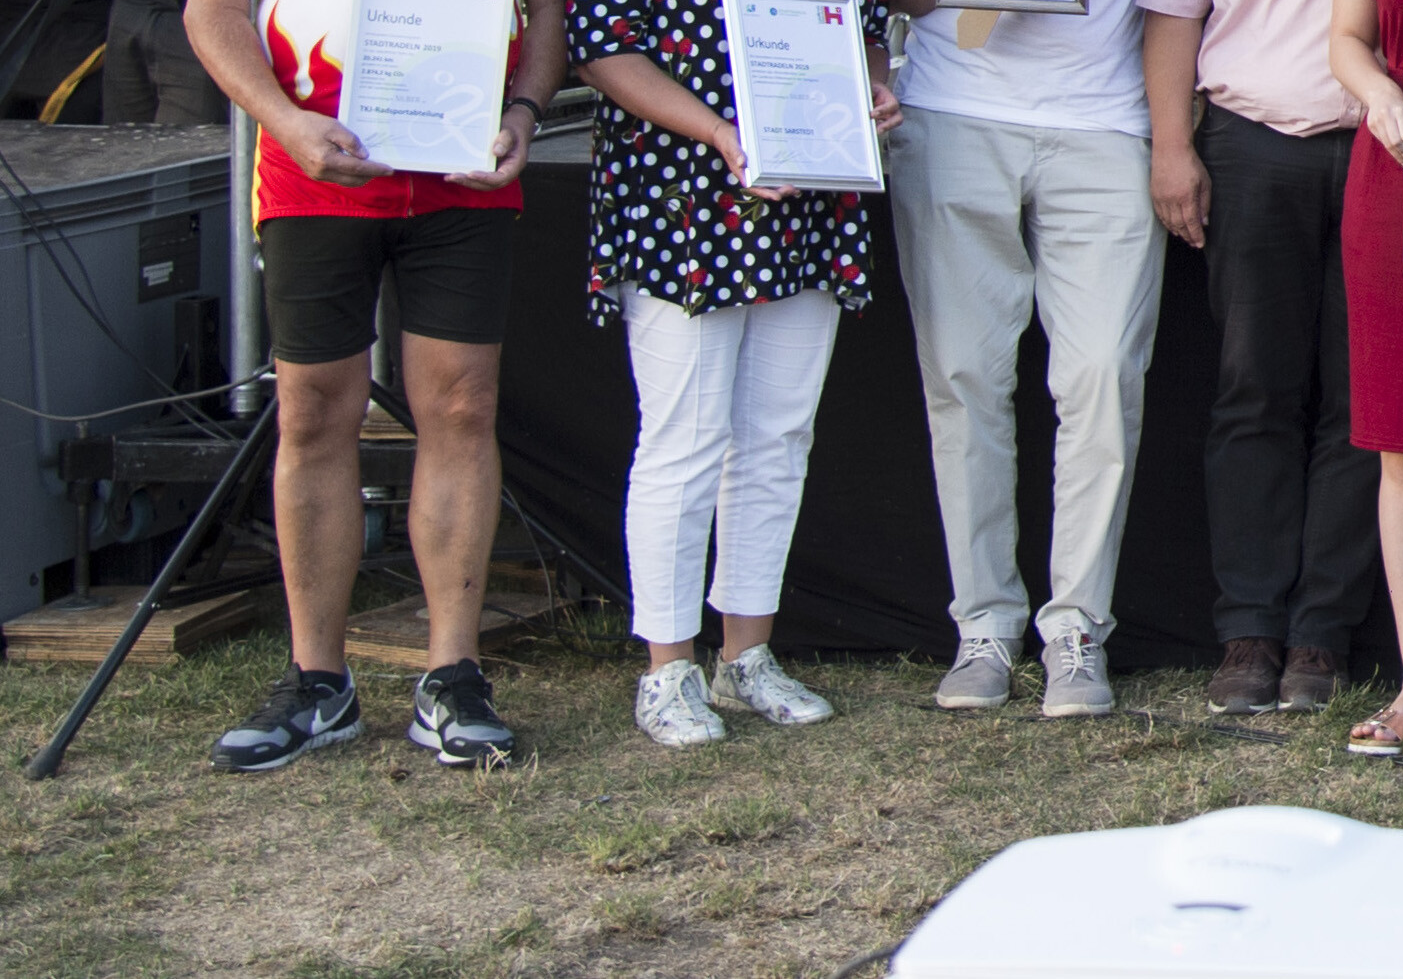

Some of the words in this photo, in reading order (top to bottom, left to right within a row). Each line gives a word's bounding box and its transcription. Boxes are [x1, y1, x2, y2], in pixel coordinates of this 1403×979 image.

[367, 8, 423, 26] Urkunde
[364, 39, 420, 51] STADTRADELN
[423, 44, 442, 52] 2019
[746, 36, 790, 51] Urkunde
